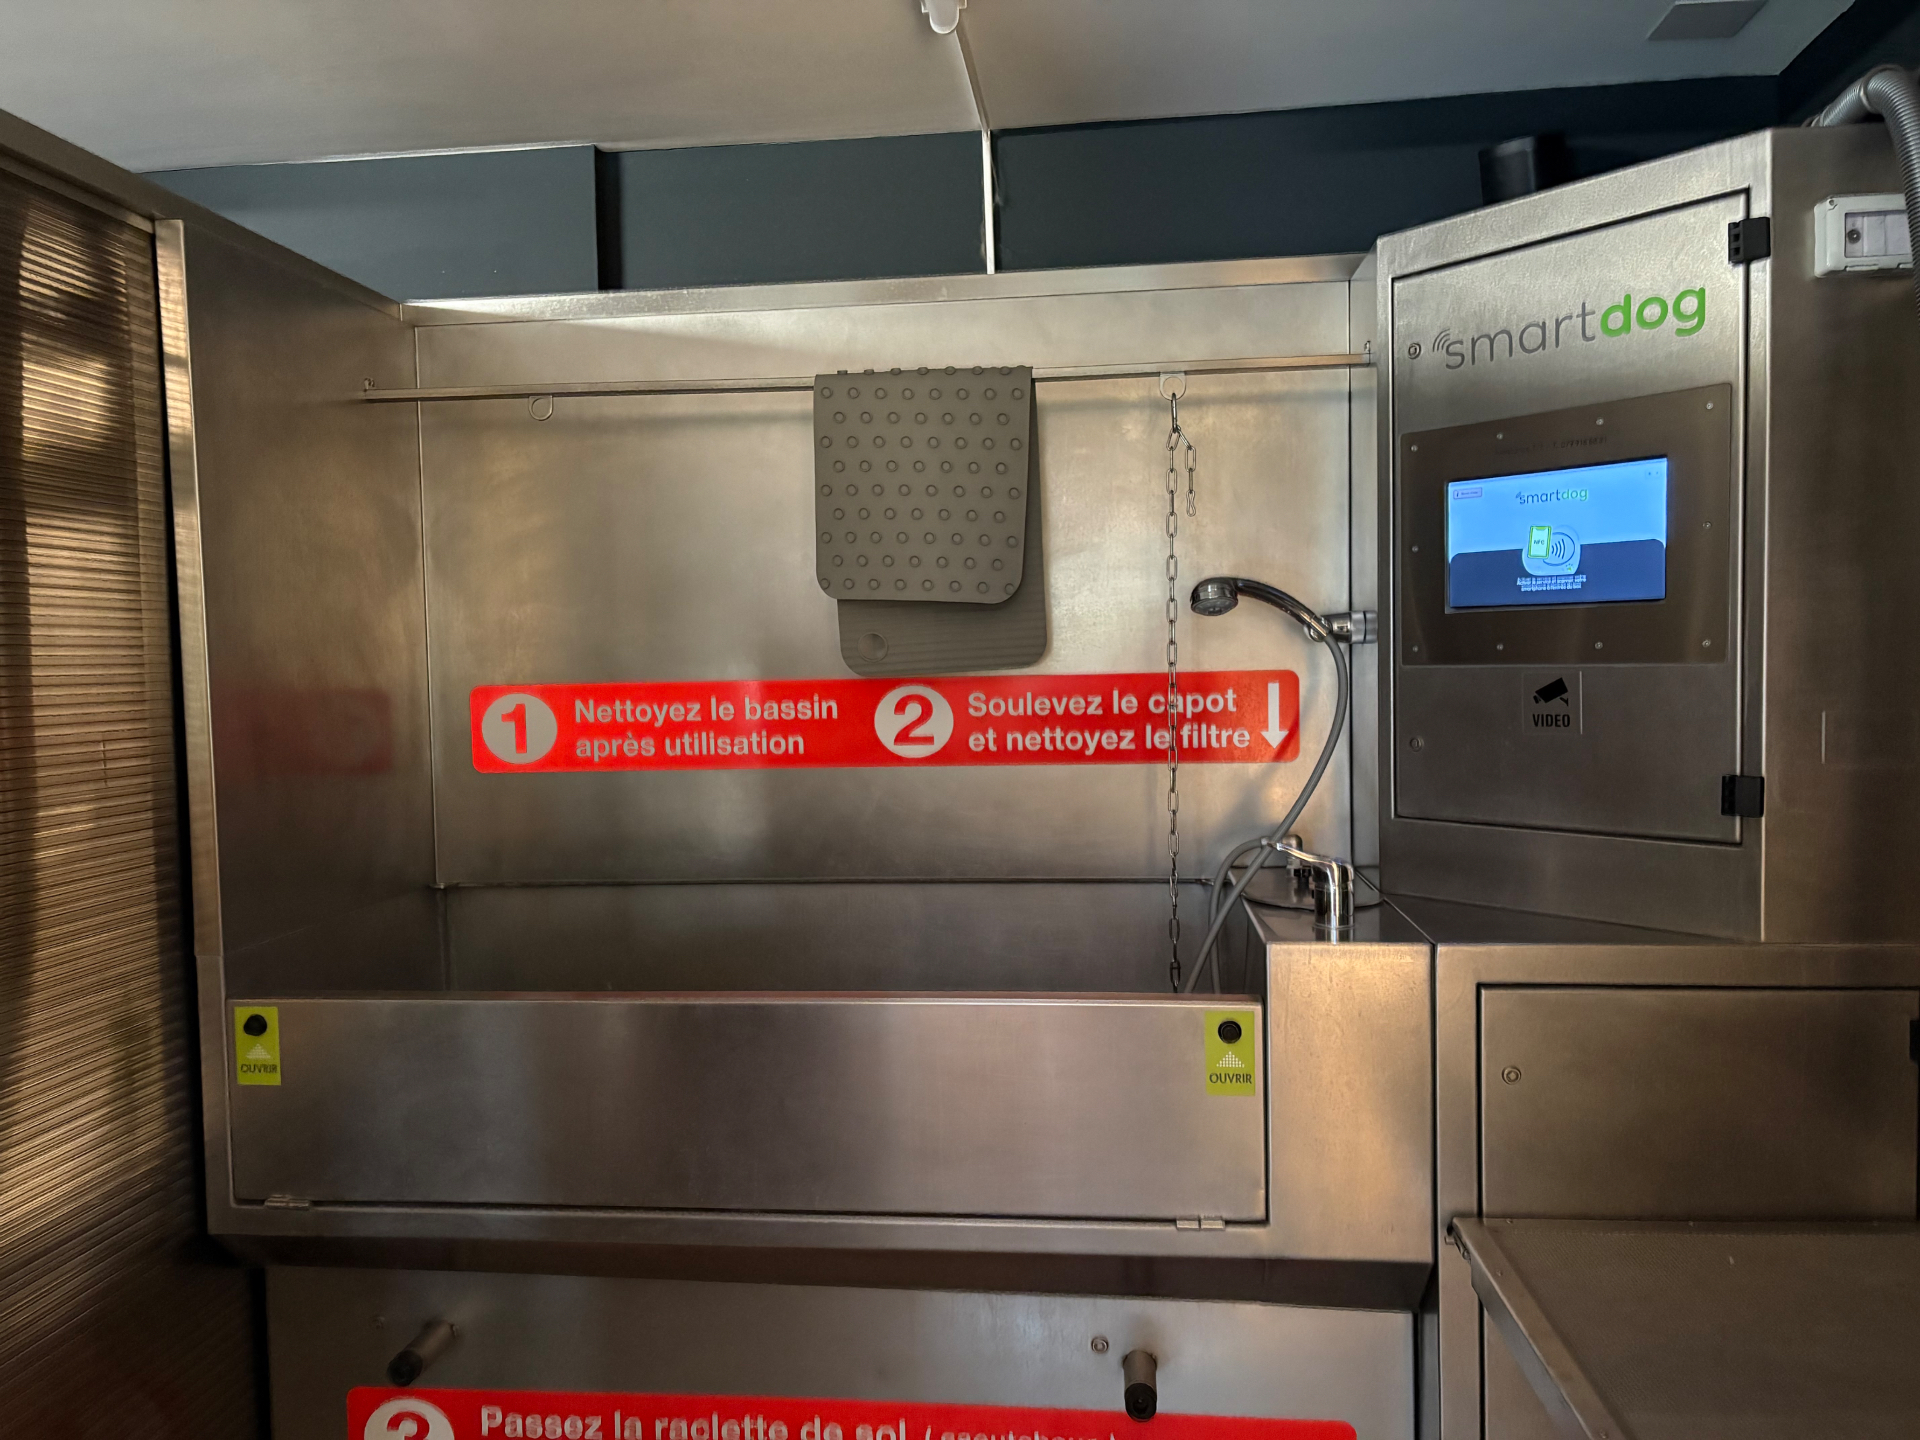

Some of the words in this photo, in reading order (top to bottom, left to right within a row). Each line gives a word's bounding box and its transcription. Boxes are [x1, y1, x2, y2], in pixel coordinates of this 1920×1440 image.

[1444, 286, 1706, 370] smartdog
[1519, 488, 1588, 504] smartdog
[574, 699, 702, 727] Nettoyez
[711, 695, 735, 721] le
[745, 693, 838, 721] bassin
[967, 690, 1103, 717] Soulevez
[1113, 688, 1139, 714] le
[501, 703, 528, 754] 1
[893, 693, 935, 747] 2
[1532, 713, 1571, 728] VIDEO
[575, 733, 656, 762] après
[664, 732, 805, 757] utilisation
[968, 727, 998, 751] et
[1006, 726, 1136, 756] nettoyez
[1145, 723, 1171, 750] le
[1180, 722, 1251, 749] filtre
[241, 1063, 278, 1074] OUVRIR
[1209, 1072, 1252, 1084] OUVRIR
